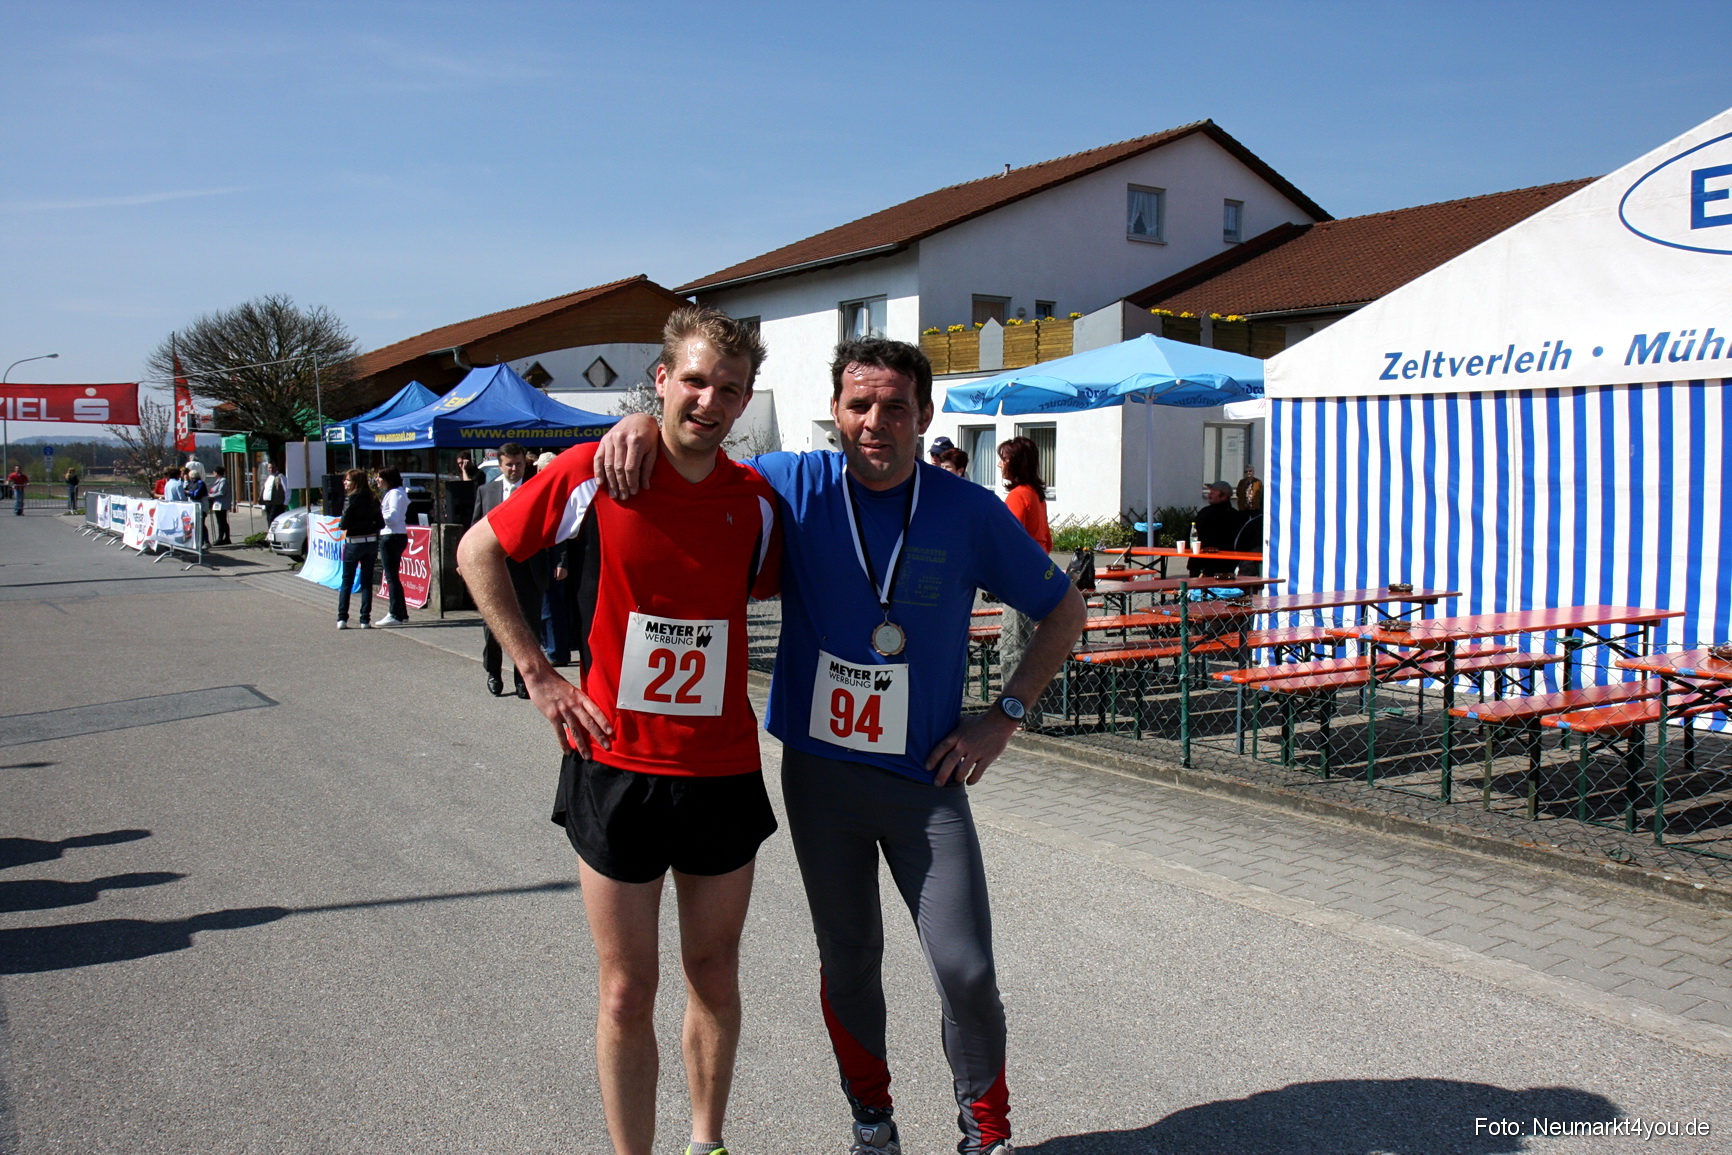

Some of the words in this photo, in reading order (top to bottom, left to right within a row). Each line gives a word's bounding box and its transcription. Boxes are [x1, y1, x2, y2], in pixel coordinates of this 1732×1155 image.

[1378, 339, 1573, 381] Zeltverleih
[317, 538, 342, 561] EMM
[645, 621, 694, 636] MEYER
[645, 633, 694, 645] WERBUNG
[643, 648, 706, 704] 22
[829, 660, 871, 680] MEYER
[829, 671, 871, 688] WERBUNG
[829, 688, 883, 743] 94
